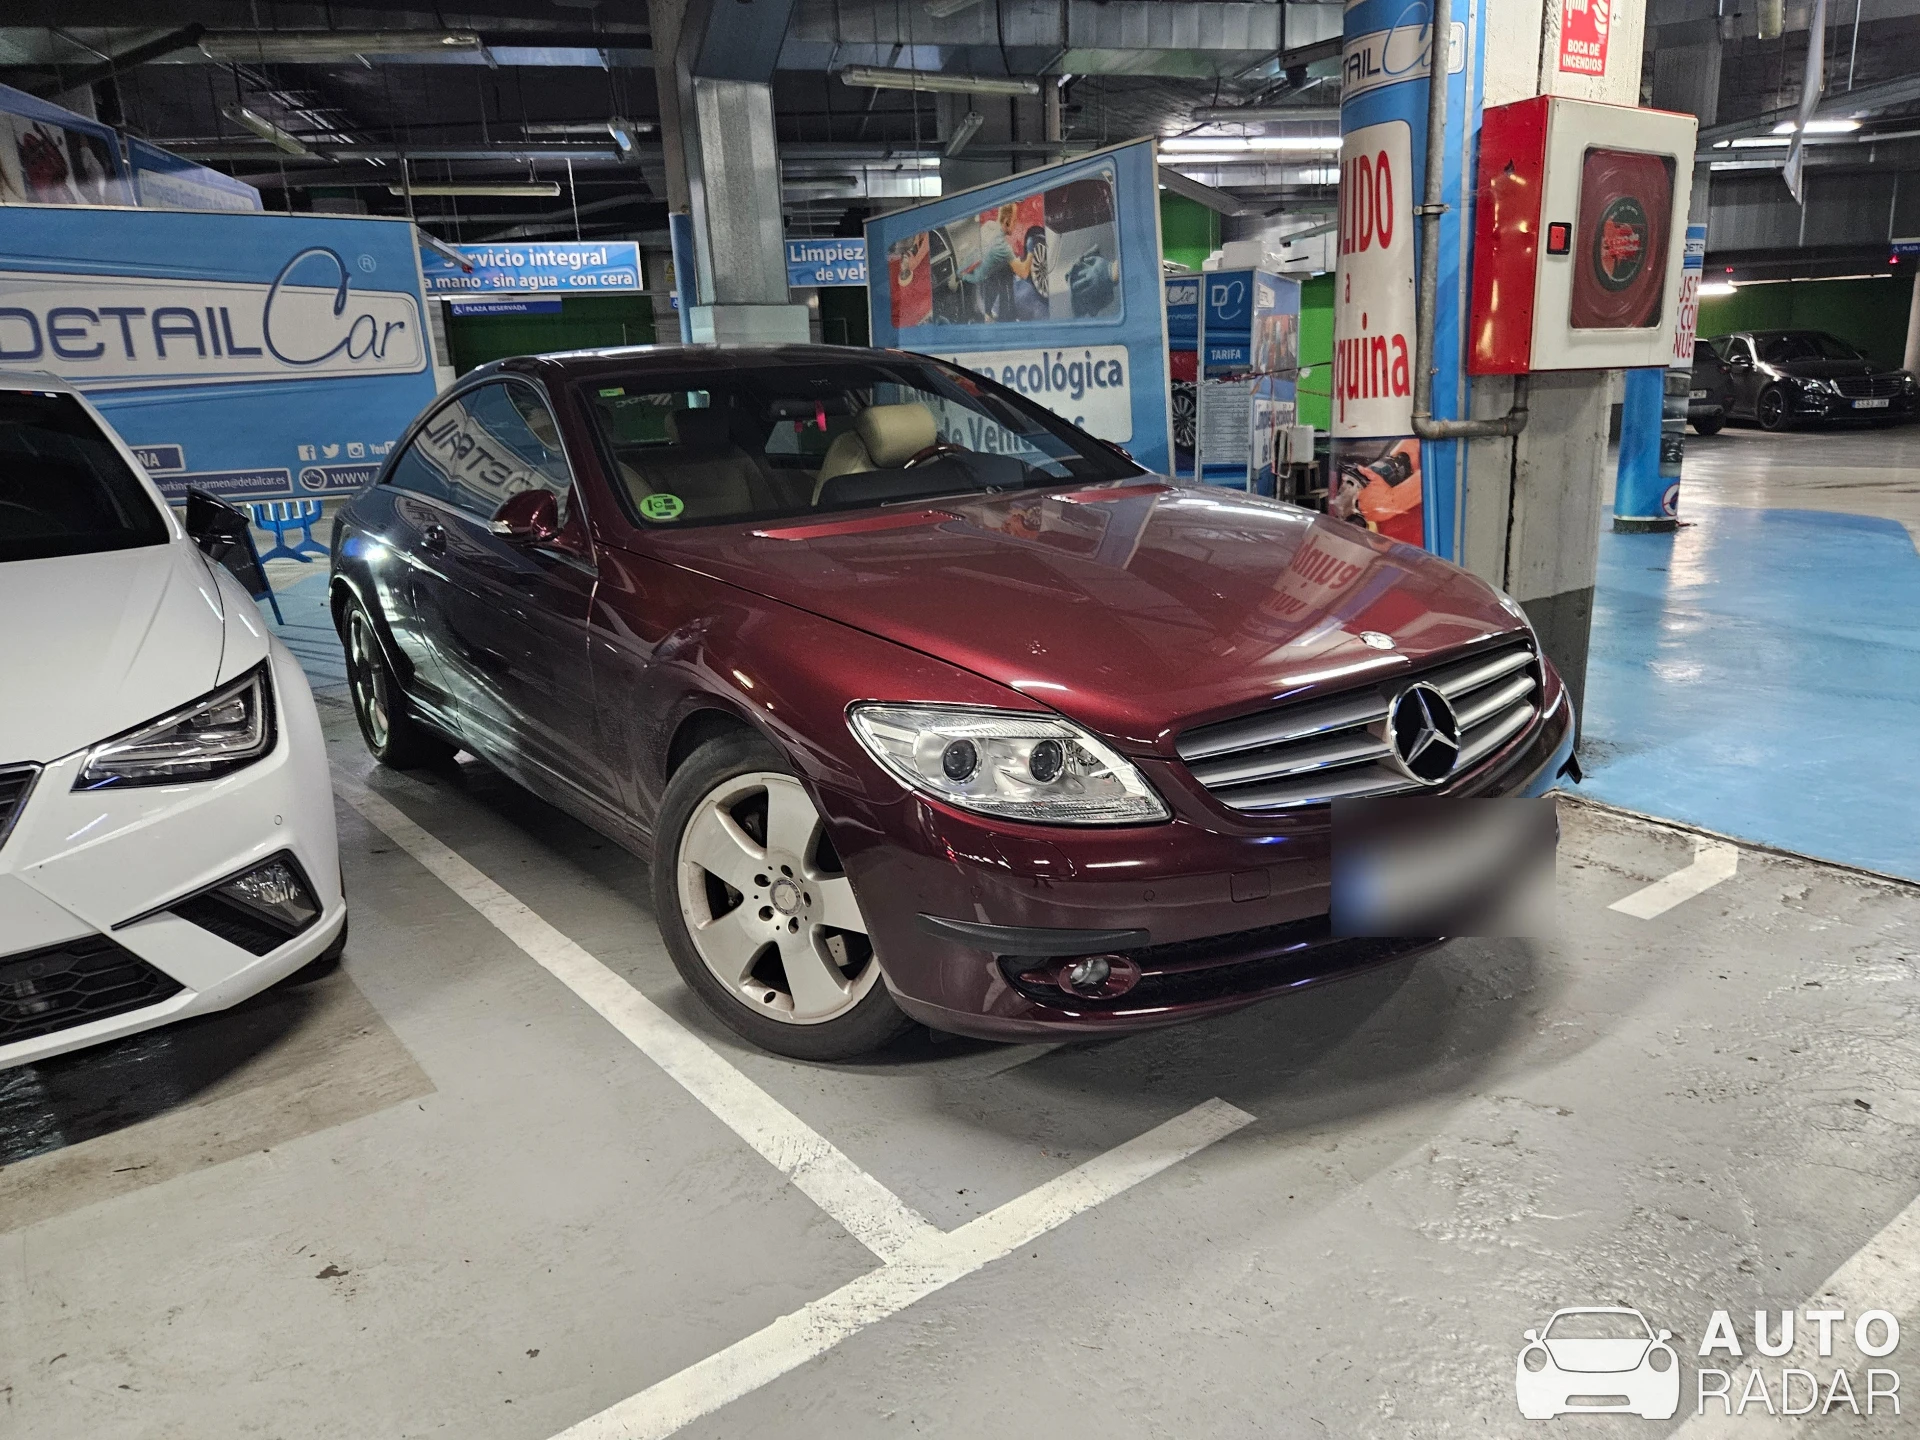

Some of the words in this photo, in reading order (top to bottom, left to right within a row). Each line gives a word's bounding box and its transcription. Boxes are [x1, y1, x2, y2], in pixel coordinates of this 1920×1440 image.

[1567, 39, 1588, 55] BOCA
[1589, 42, 1600, 57] DE
[1343, 47, 1381, 87] TAIL
[1562, 53, 1603, 73] INCENDIOS
[1340, 150, 1394, 256] LIDO
[443, 249, 525, 268] rvicio
[529, 247, 608, 270] integral
[790, 246, 865, 265] Limpiez
[436, 277, 481, 289] mano
[492, 273, 515, 288] sin
[519, 274, 558, 291] agua
[569, 275, 597, 286] con
[600, 273, 633, 286] cera
[816, 267, 834, 281] de
[837, 265, 867, 281] veh
[0, 306, 263, 361] DETAIL
[263, 246, 405, 366] Car
[489, 304, 527, 312] RESERVADA
[1211, 348, 1241, 361] TARIFA
[1002, 350, 1124, 400] ecológica
[136, 450, 161, 467] ÑA
[331, 471, 370, 485] www
